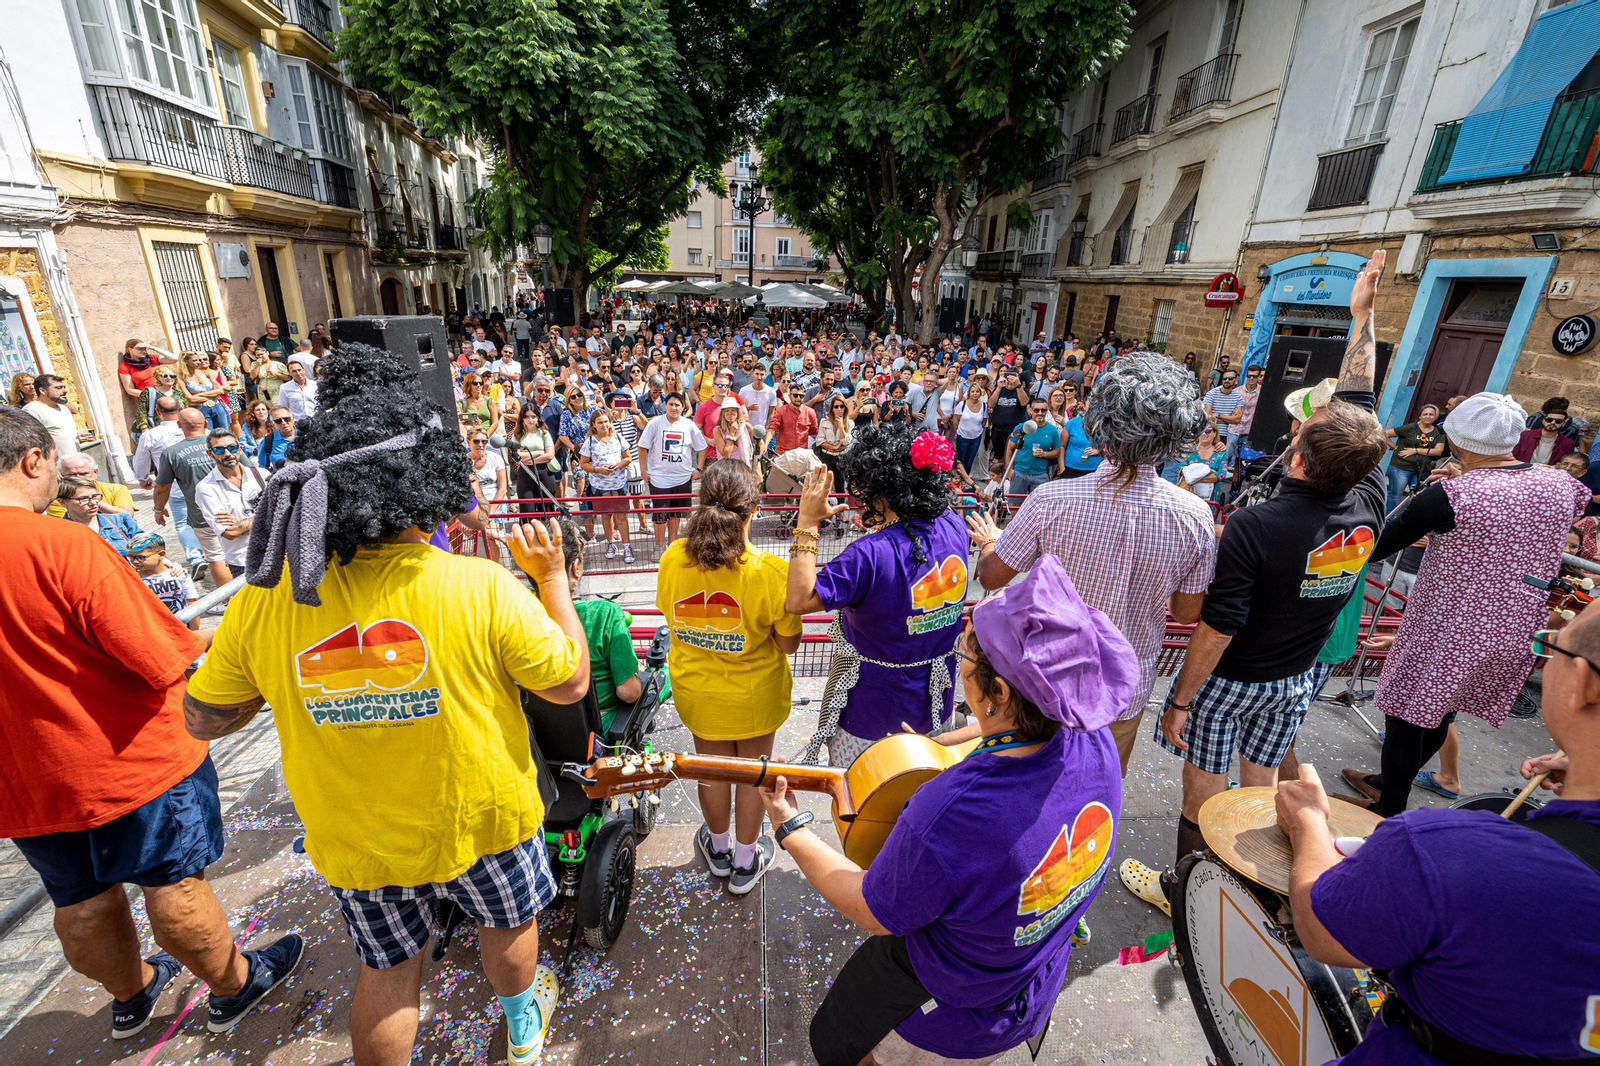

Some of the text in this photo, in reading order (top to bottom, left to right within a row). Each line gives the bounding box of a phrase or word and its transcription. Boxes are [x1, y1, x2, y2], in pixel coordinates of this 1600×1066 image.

[1332, 269, 1357, 280] MARISQUE
[1549, 281, 1569, 293] 15
[661, 454, 683, 462] FILA
[148, 579, 180, 595] ARVEL
[1301, 579, 1320, 588] LOS
[907, 614, 924, 626] LOS
[673, 625, 746, 642] LOS CUARENTENAS
[676, 633, 744, 652] PRINCIPALES
[304, 687, 440, 710] LOS CUARENTENAS
[311, 700, 439, 726] PRINCIPALES
[1194, 868, 1215, 888] Cádiz
[1014, 919, 1041, 940] LOS
[115, 1014, 135, 1022] FILA
